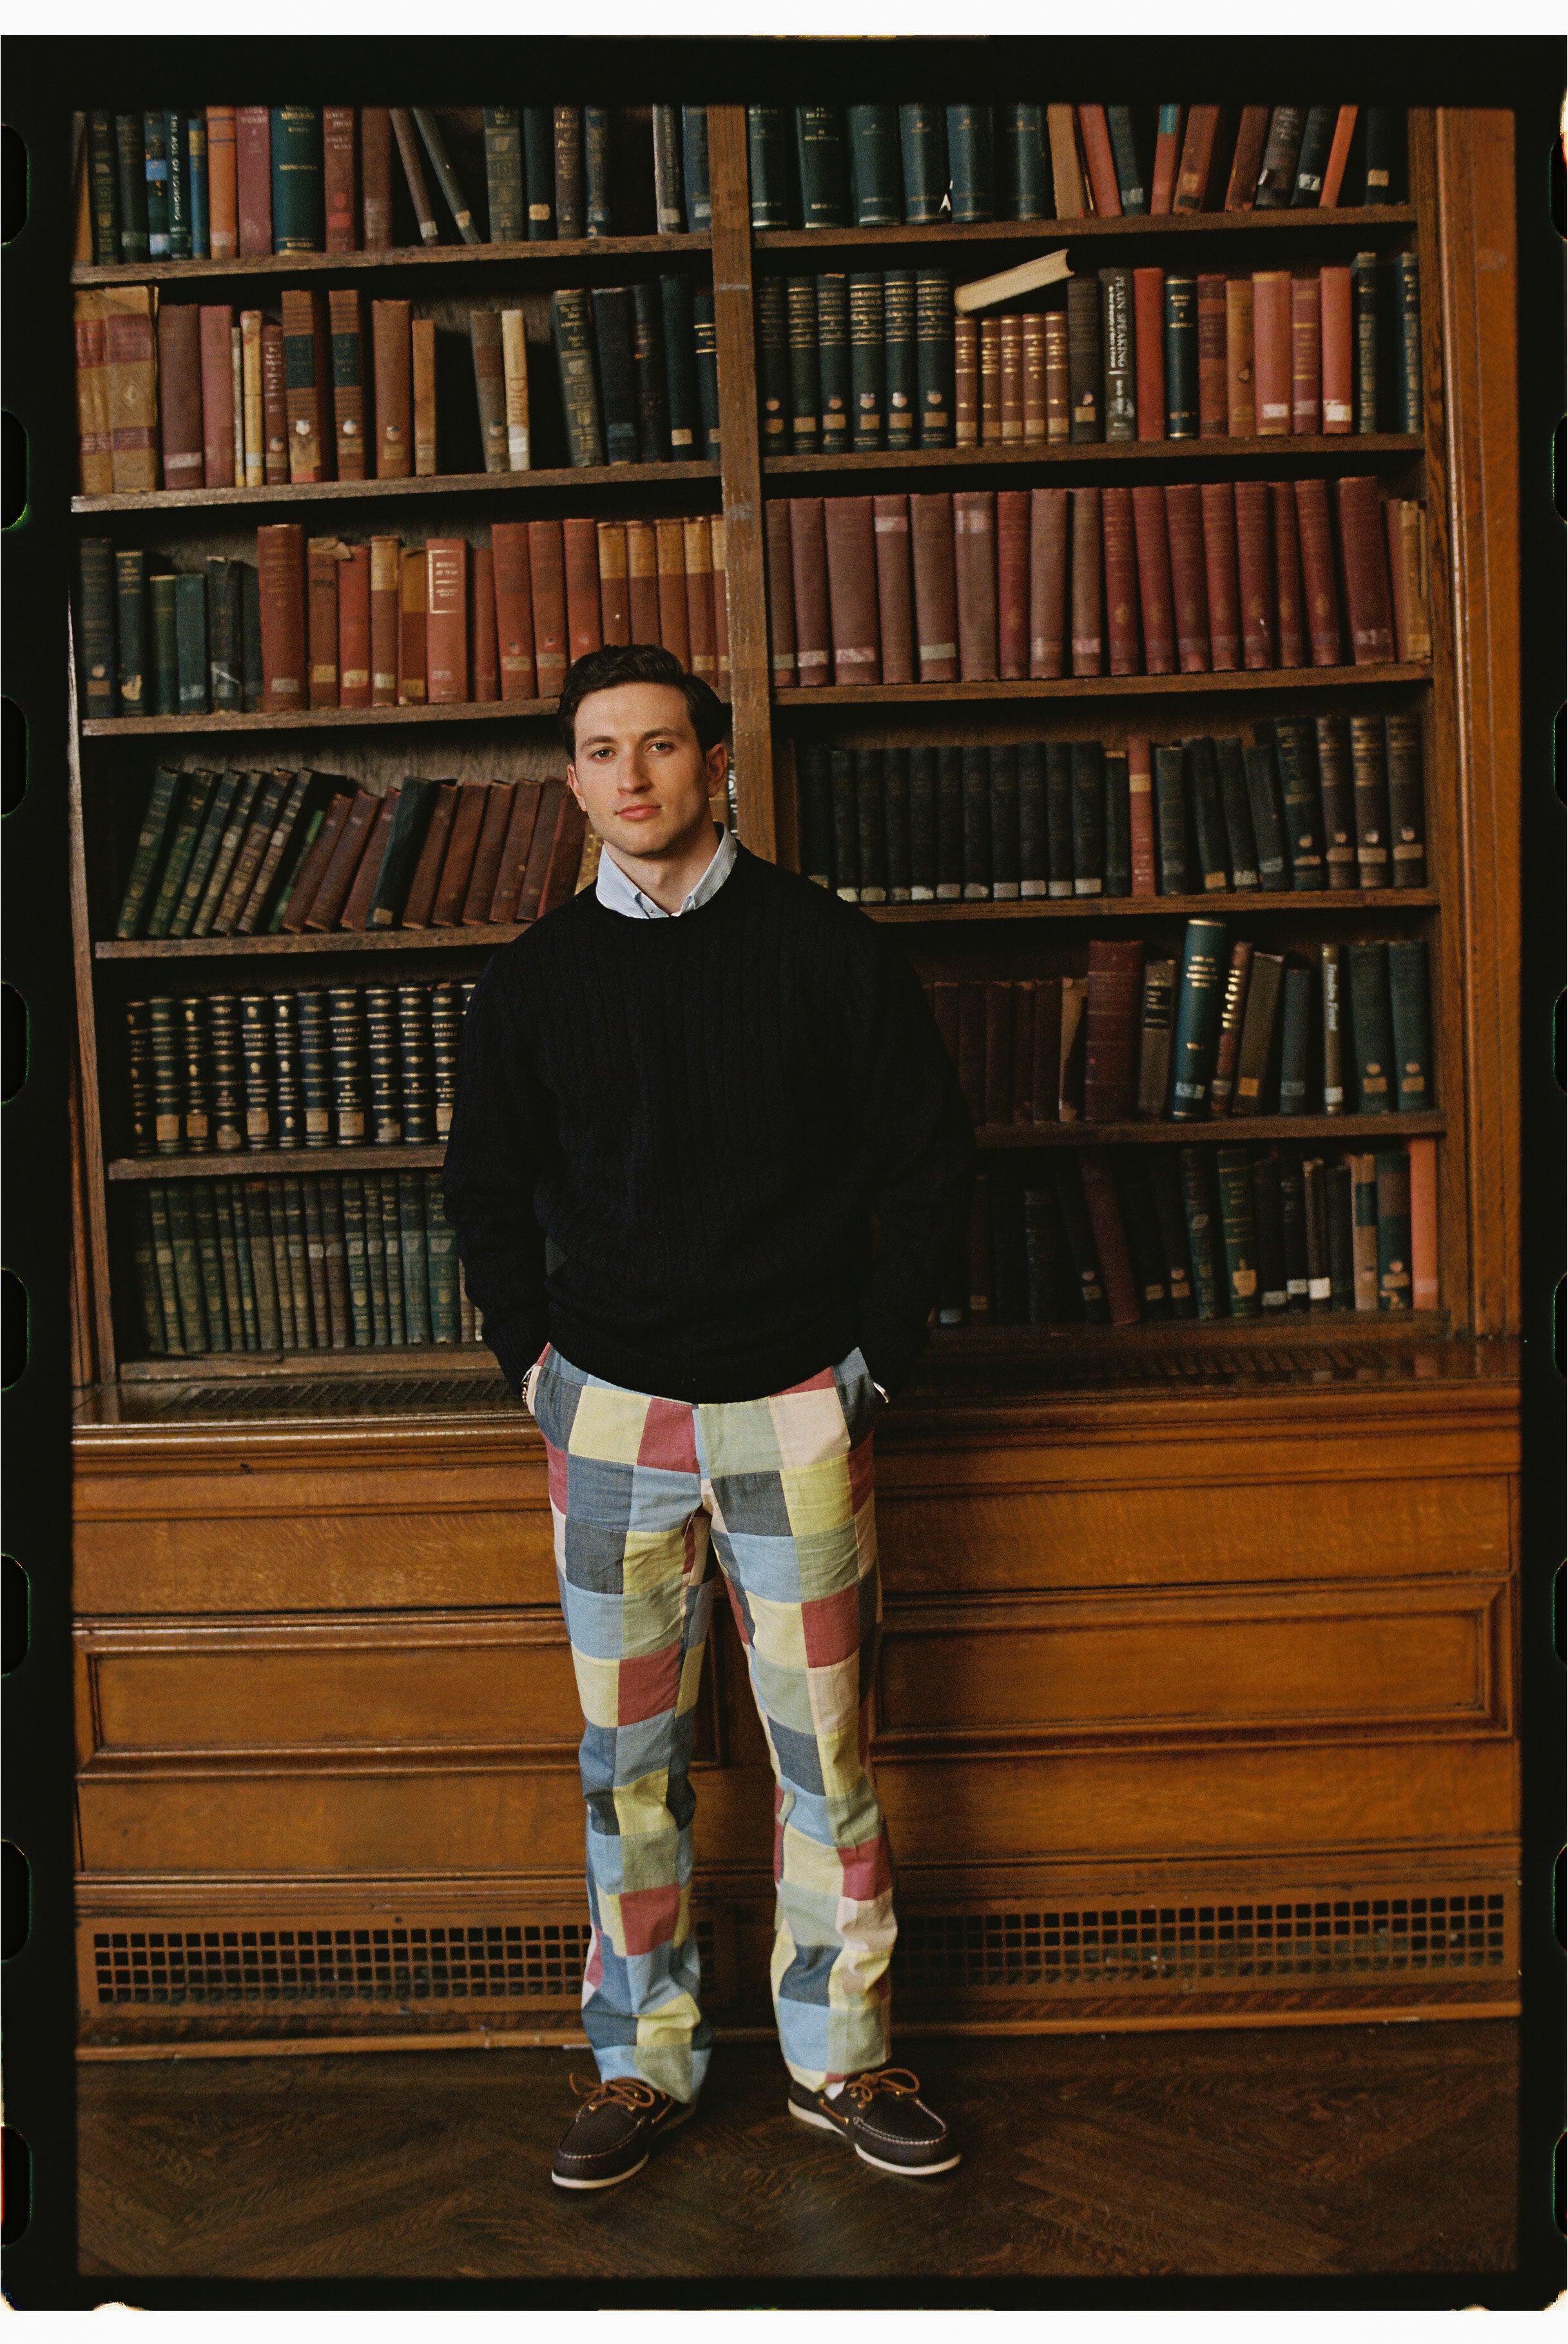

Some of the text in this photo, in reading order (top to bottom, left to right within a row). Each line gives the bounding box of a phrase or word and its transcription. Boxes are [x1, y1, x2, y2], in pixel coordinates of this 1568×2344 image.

[170, 115, 179, 133] THE
[171, 135, 179, 155] AGE
[171, 159, 180, 171] OF
[1115, 276, 1126, 309] PLAIN
[1116, 313, 1127, 367] SPEAKING
